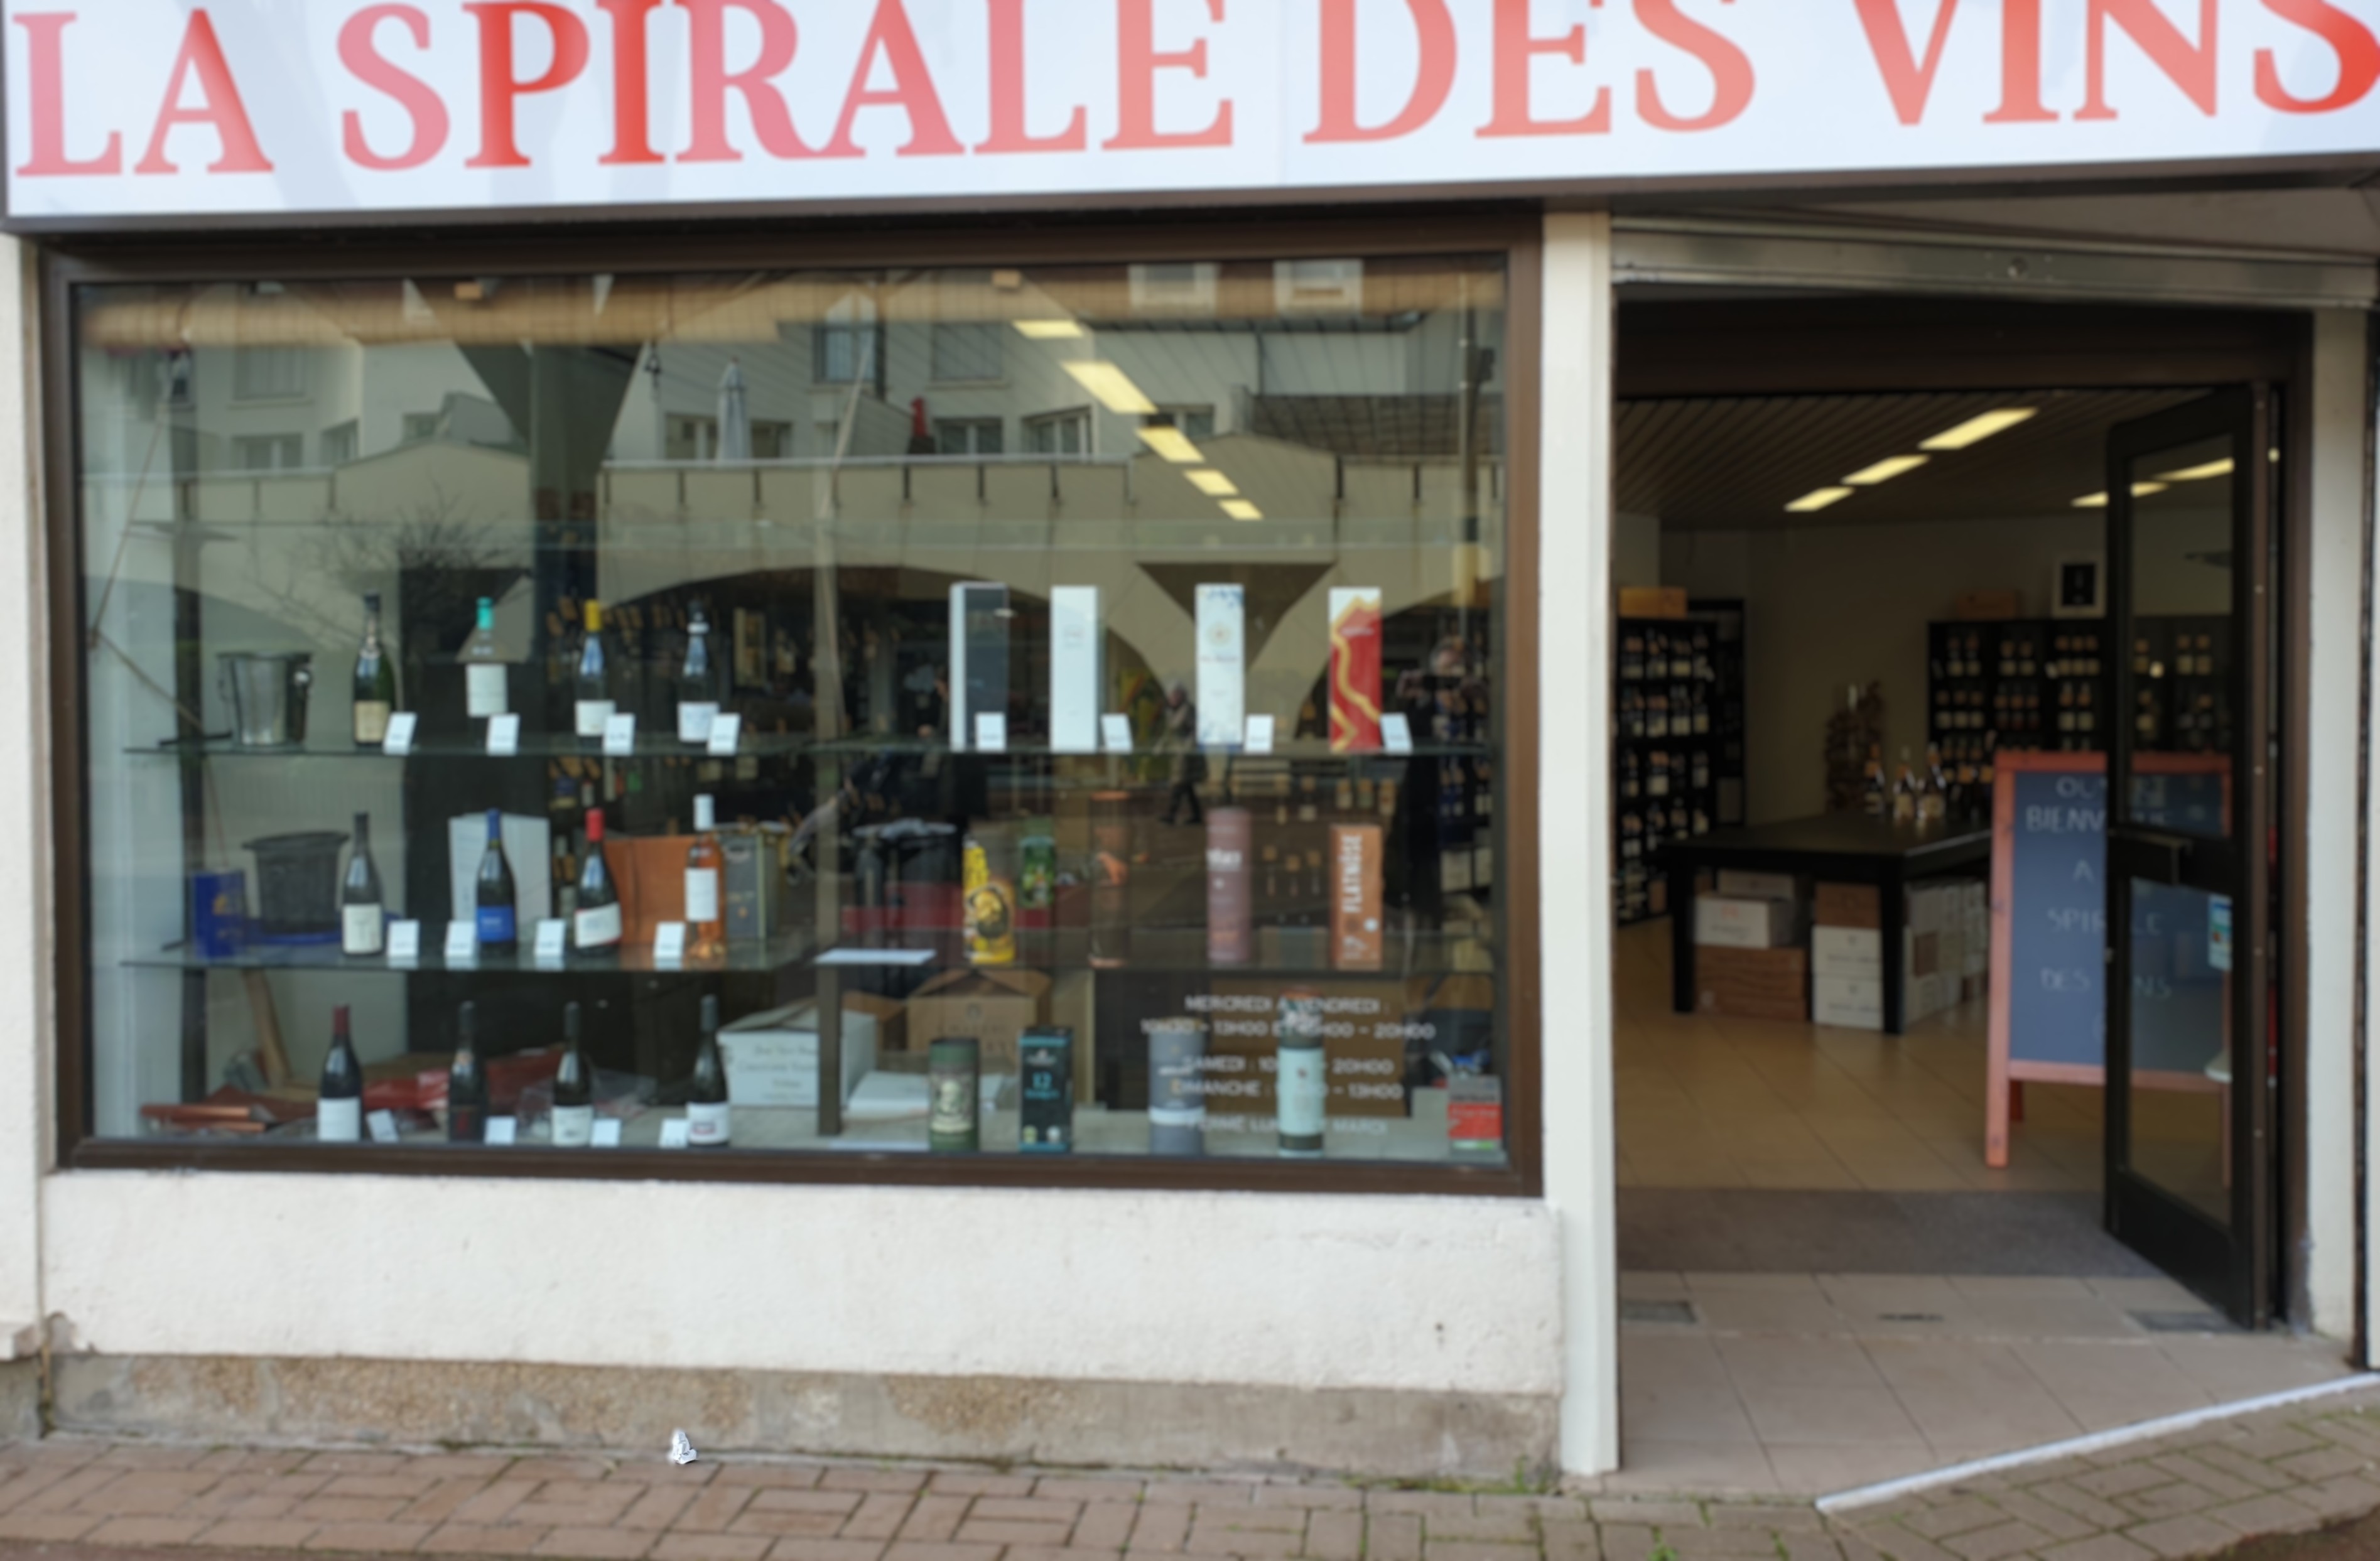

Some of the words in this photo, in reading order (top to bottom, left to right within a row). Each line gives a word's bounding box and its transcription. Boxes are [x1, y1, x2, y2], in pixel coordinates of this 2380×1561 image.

[13, 8, 274, 176] LA
[336, 0, 1233, 171] SPIRALE
[1303, 0, 1755, 144] DES
[1854, 0, 2380, 126] VINS
[2040, 966, 2090, 992] DES
[1185, 995, 1272, 1012] MERCREDI
[1214, 1020, 1268, 1037] 13H00
[1374, 1023, 1436, 1040] 20H00
[1333, 1057, 1394, 1075] 20H00
[1348, 1083, 1404, 1100] 13H00
